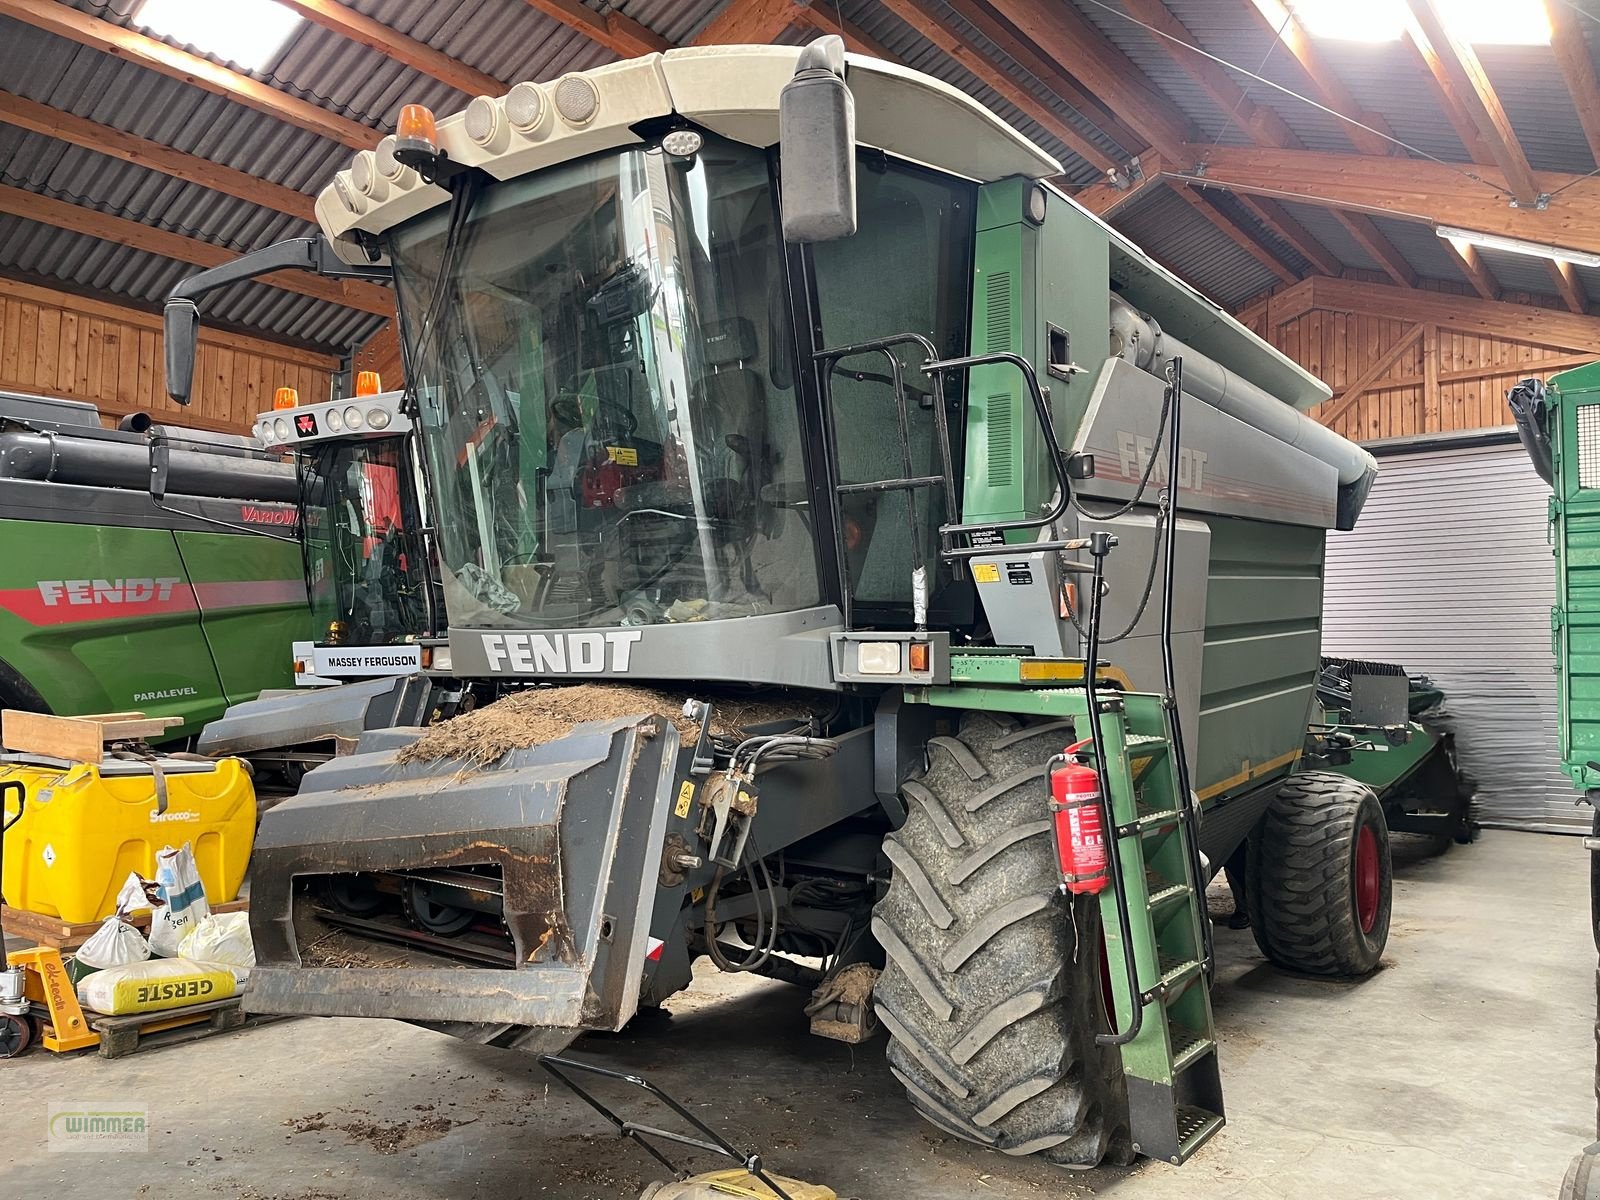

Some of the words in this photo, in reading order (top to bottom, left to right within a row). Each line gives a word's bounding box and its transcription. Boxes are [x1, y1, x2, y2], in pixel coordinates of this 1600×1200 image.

[1116, 430, 1208, 490] FENDT
[37, 577, 180, 606] FENDT
[328, 657, 362, 667] MASSEY
[364, 655, 416, 666] FERGUSON
[481, 630, 642, 673] FENDT
[133, 687, 198, 702] PARALEVEL
[137, 979, 214, 1003] GERSTE
